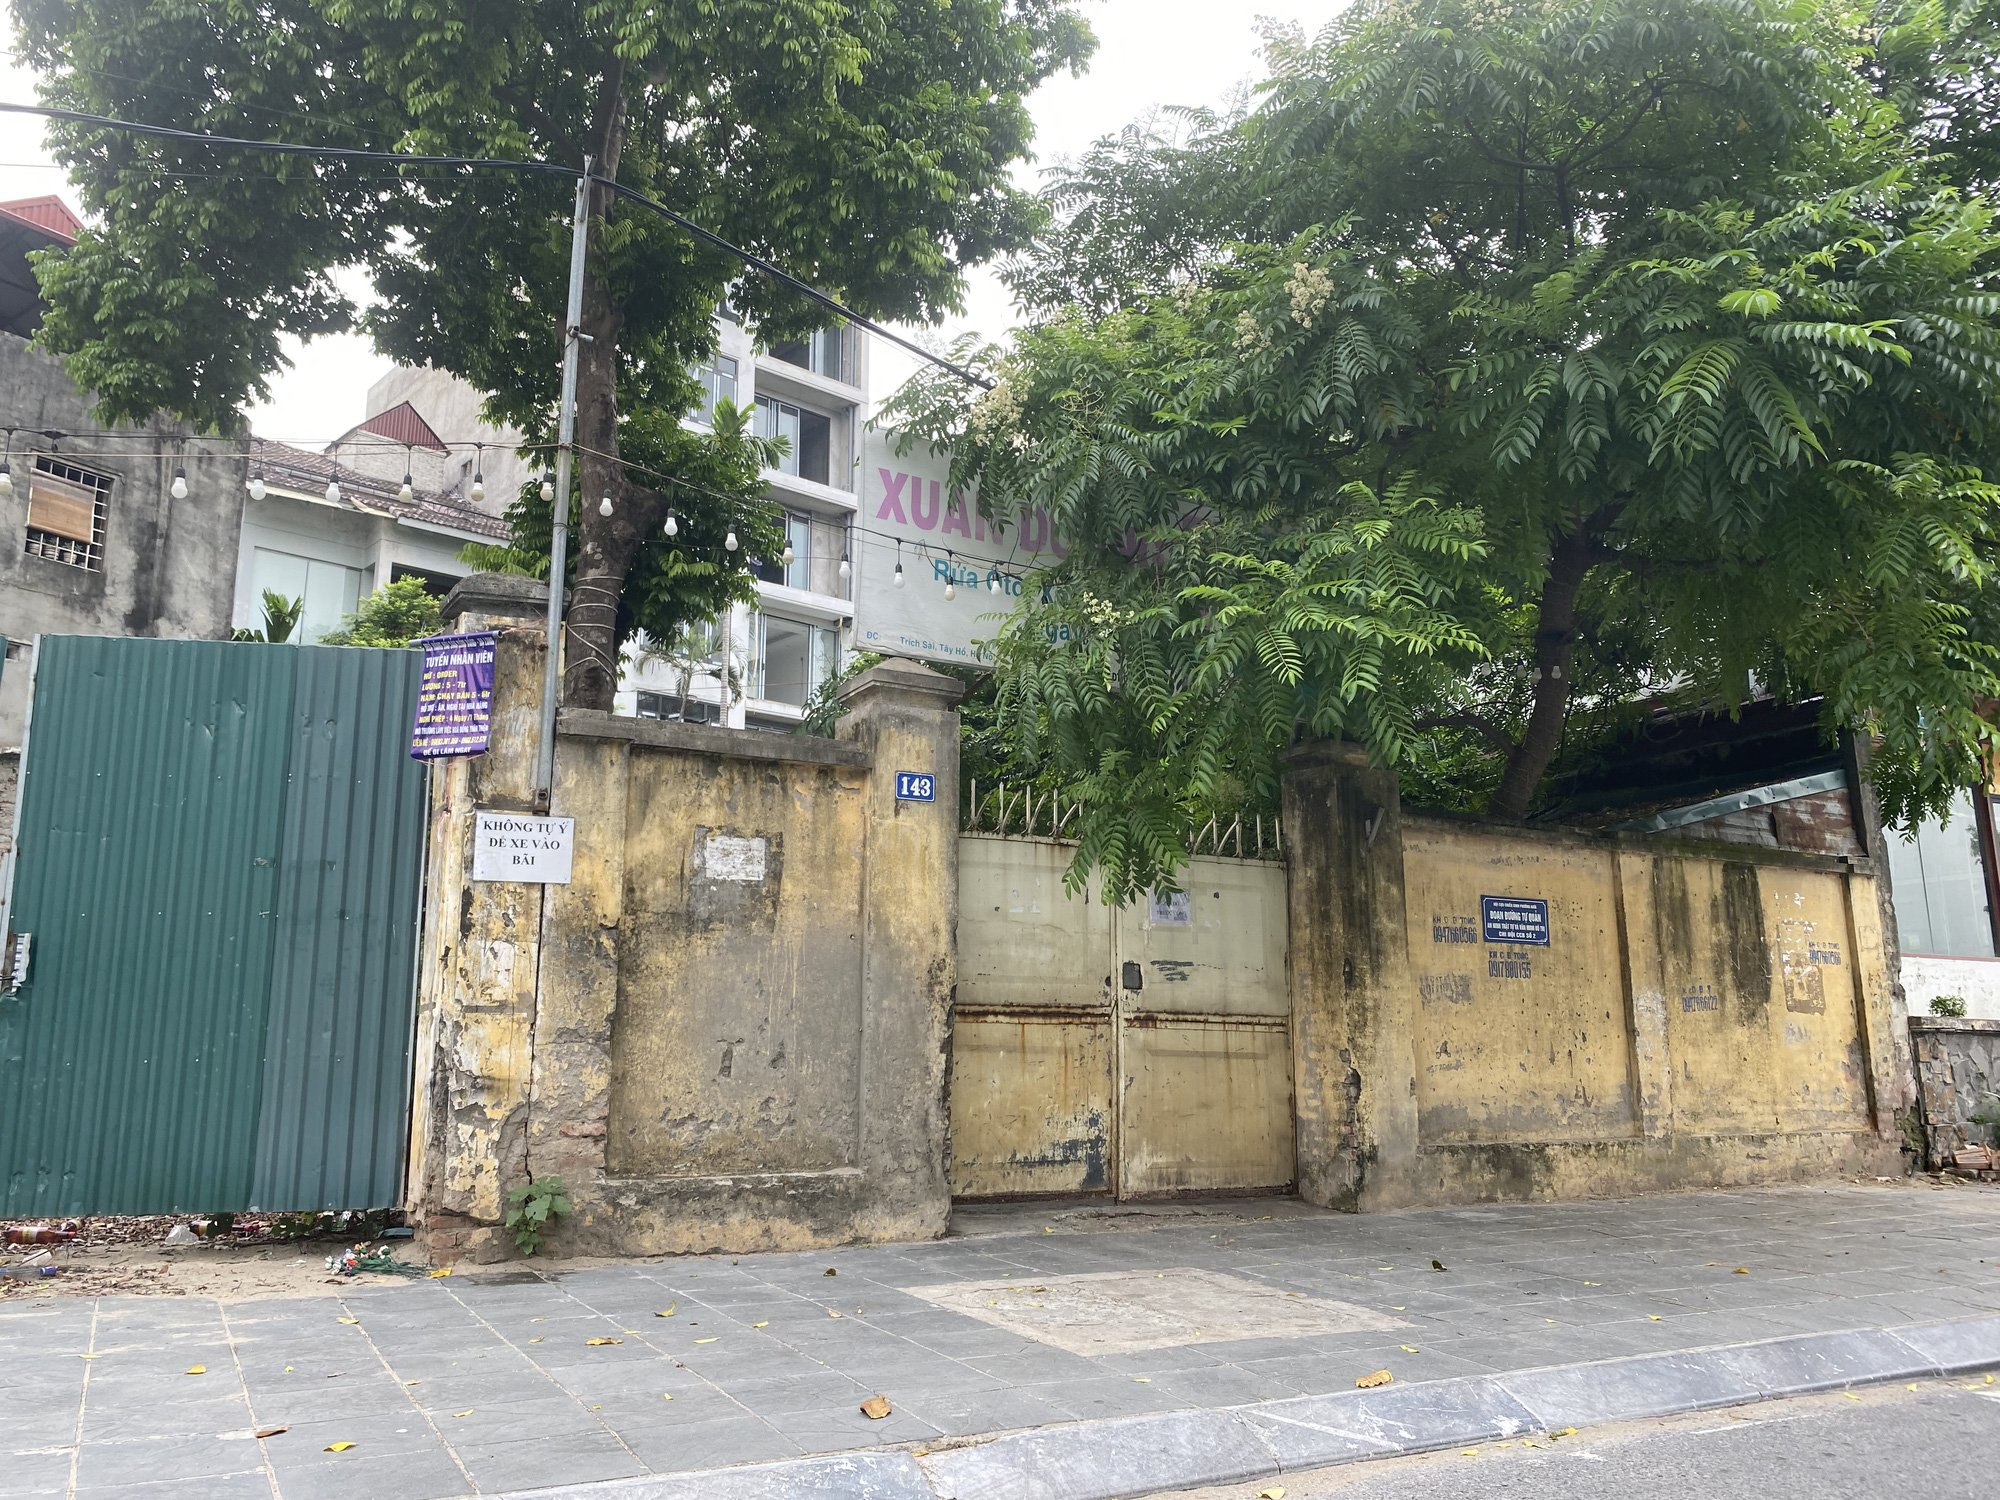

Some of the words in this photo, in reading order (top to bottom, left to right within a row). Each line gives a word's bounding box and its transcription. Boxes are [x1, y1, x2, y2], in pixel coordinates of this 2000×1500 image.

[900, 636, 920, 647] Trích
[940, 643, 954, 655] Tây
[426, 652, 449, 668] TUYỂN
[450, 652, 474, 665] NHÂN
[476, 650, 493, 663] VIÊN
[437, 670, 457, 678] ORDER
[437, 692, 455, 701] CHẠY
[902, 776, 931, 797] 143
[484, 819, 533, 833] KHÔNG
[537, 823, 556, 836] TỰ
[559, 821, 569, 834] Ý
[510, 839, 528, 848] XE
[532, 837, 560, 850] VÀO
[512, 853, 535, 865] BÃI
